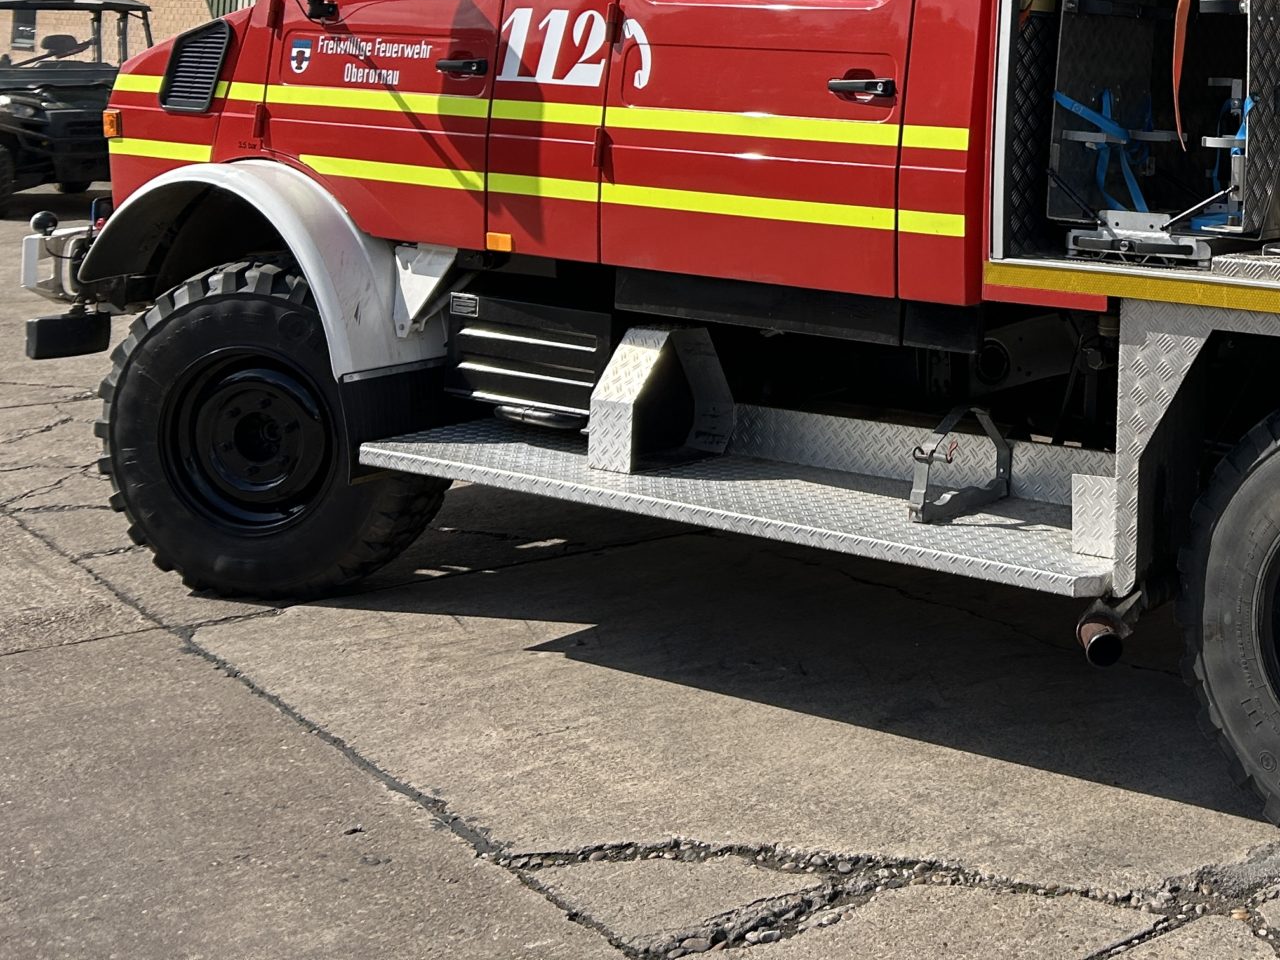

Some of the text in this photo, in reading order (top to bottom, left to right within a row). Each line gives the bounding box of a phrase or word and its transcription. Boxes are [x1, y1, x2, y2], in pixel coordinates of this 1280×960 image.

[318, 36, 432, 59] Freiwillige Feuerwehr
[496, 7, 607, 87] 112
[344, 63, 400, 85] Oberornau
